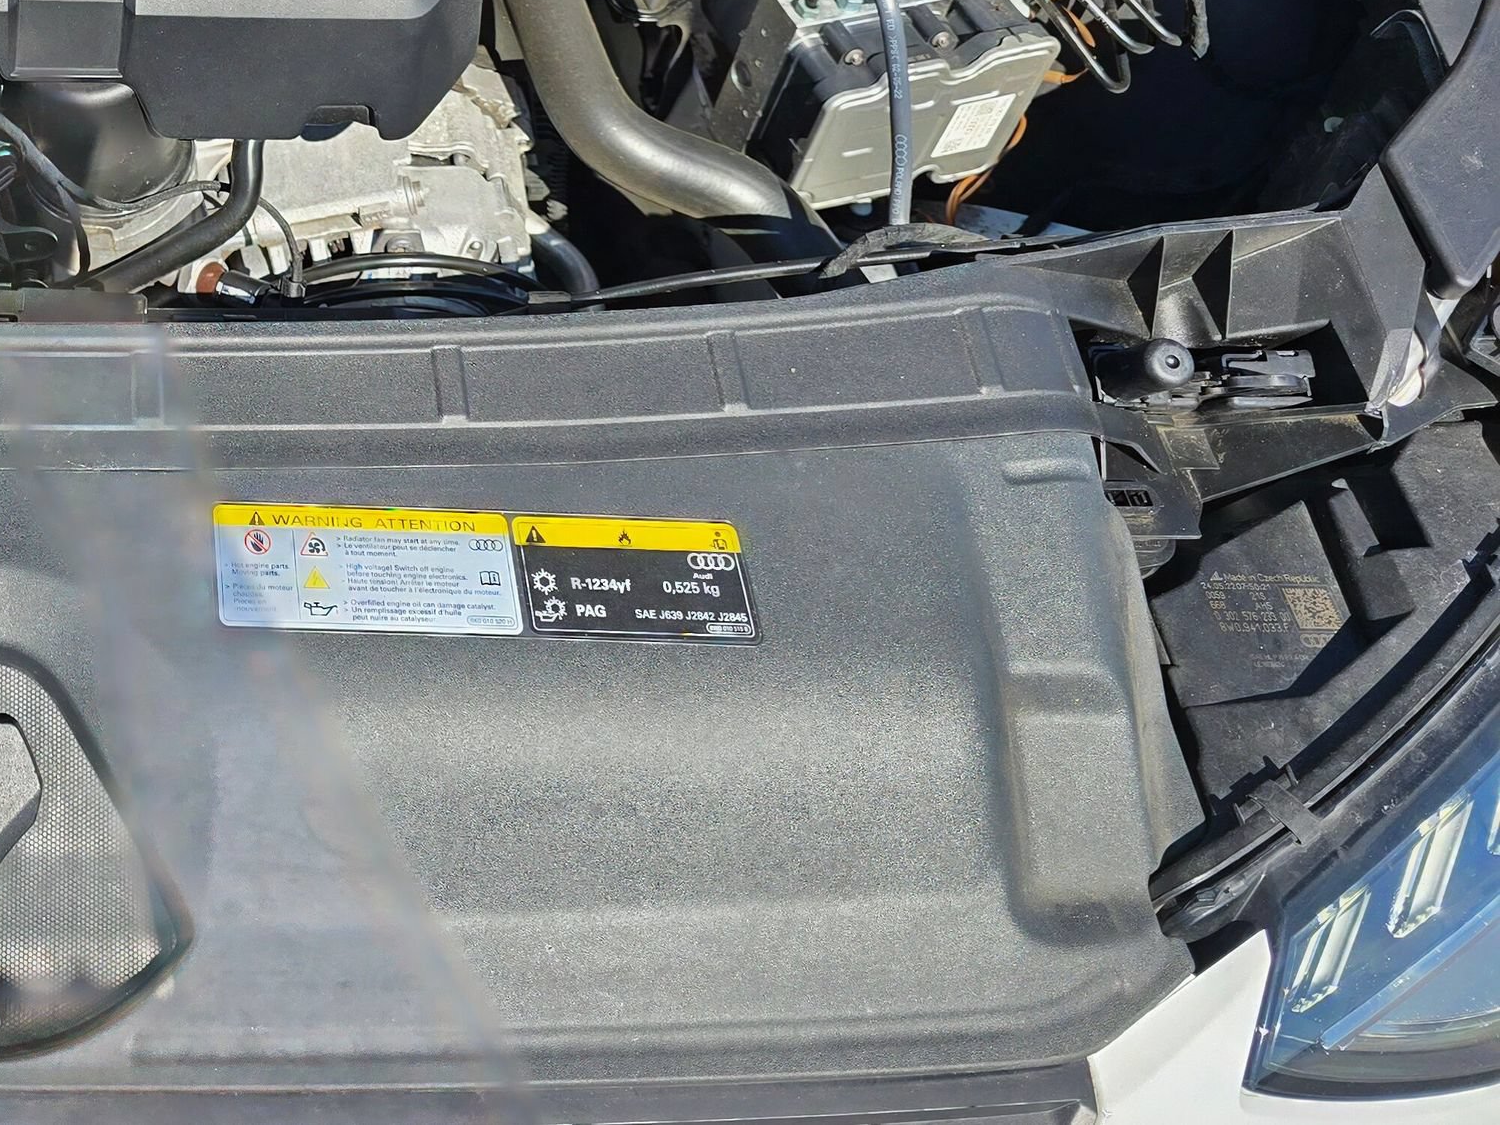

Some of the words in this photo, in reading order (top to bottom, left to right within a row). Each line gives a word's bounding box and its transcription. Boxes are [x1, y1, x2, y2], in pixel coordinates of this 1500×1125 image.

[272, 514, 363, 528] WARNING
[376, 517, 476, 532] ATTENTION
[394, 564, 418, 572] Switch
[692, 572, 714, 580] Audi
[570, 577, 632, 594] R-1234yf
[662, 580, 701, 595] 0,525
[703, 581, 721, 597] kg
[350, 599, 385, 607] Overfilled
[386, 600, 411, 608] engine
[364, 607, 407, 616] remplissage
[575, 604, 607, 618] PAG
[635, 608, 657, 619] SAE
[658, 609, 684, 620] J639
[685, 611, 716, 621] J2842
[717, 611, 748, 622] J2845
